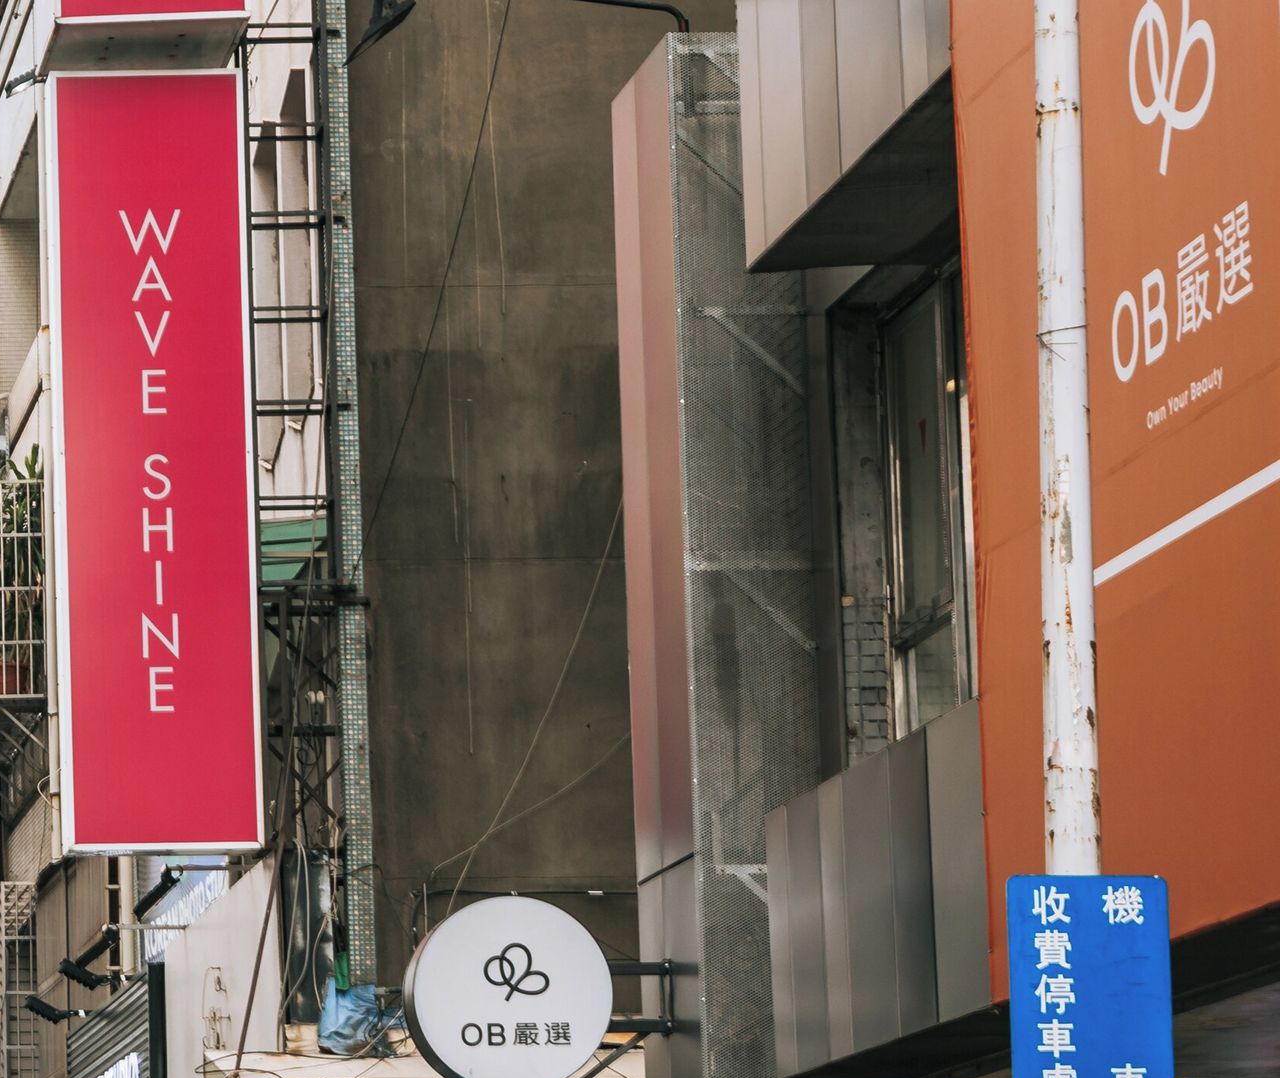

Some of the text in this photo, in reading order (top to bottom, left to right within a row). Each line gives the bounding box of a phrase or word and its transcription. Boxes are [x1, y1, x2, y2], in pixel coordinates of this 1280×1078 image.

[118, 208, 181, 416] WAVE
[1111, 200, 1255, 383] OB 嚴選
[1146, 366, 1224, 431] Own Your Beauty
[140, 452, 180, 713] SHINE
[460, 1020, 572, 1047] OB 嚴選
